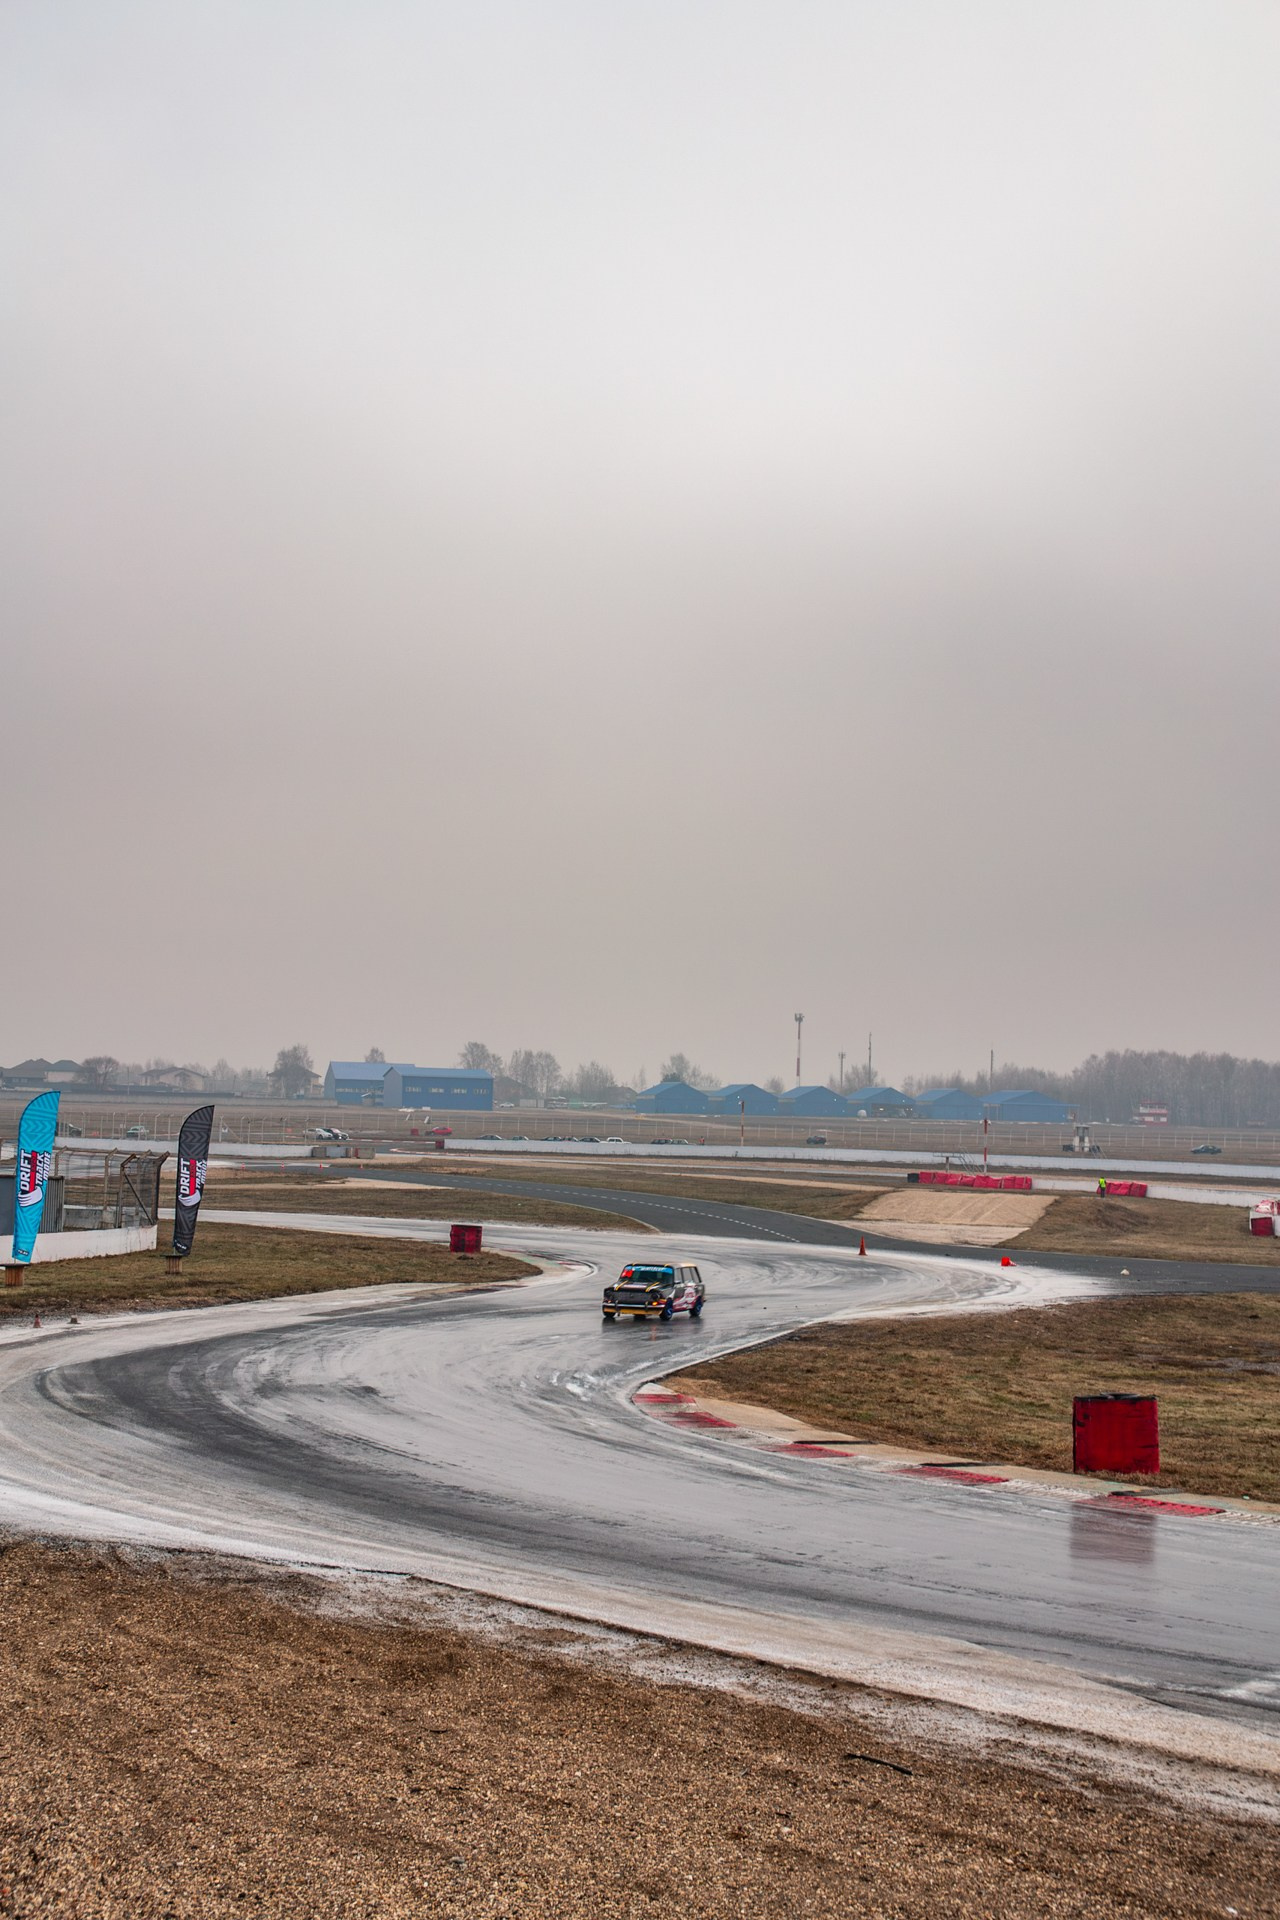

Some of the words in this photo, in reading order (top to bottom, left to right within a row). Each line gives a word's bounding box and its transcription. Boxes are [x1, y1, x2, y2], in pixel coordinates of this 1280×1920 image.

[20, 1149, 31, 1191] DRIFT
[36, 1154, 44, 1185] TRACK
[180, 1158, 190, 1194] DRIFT
